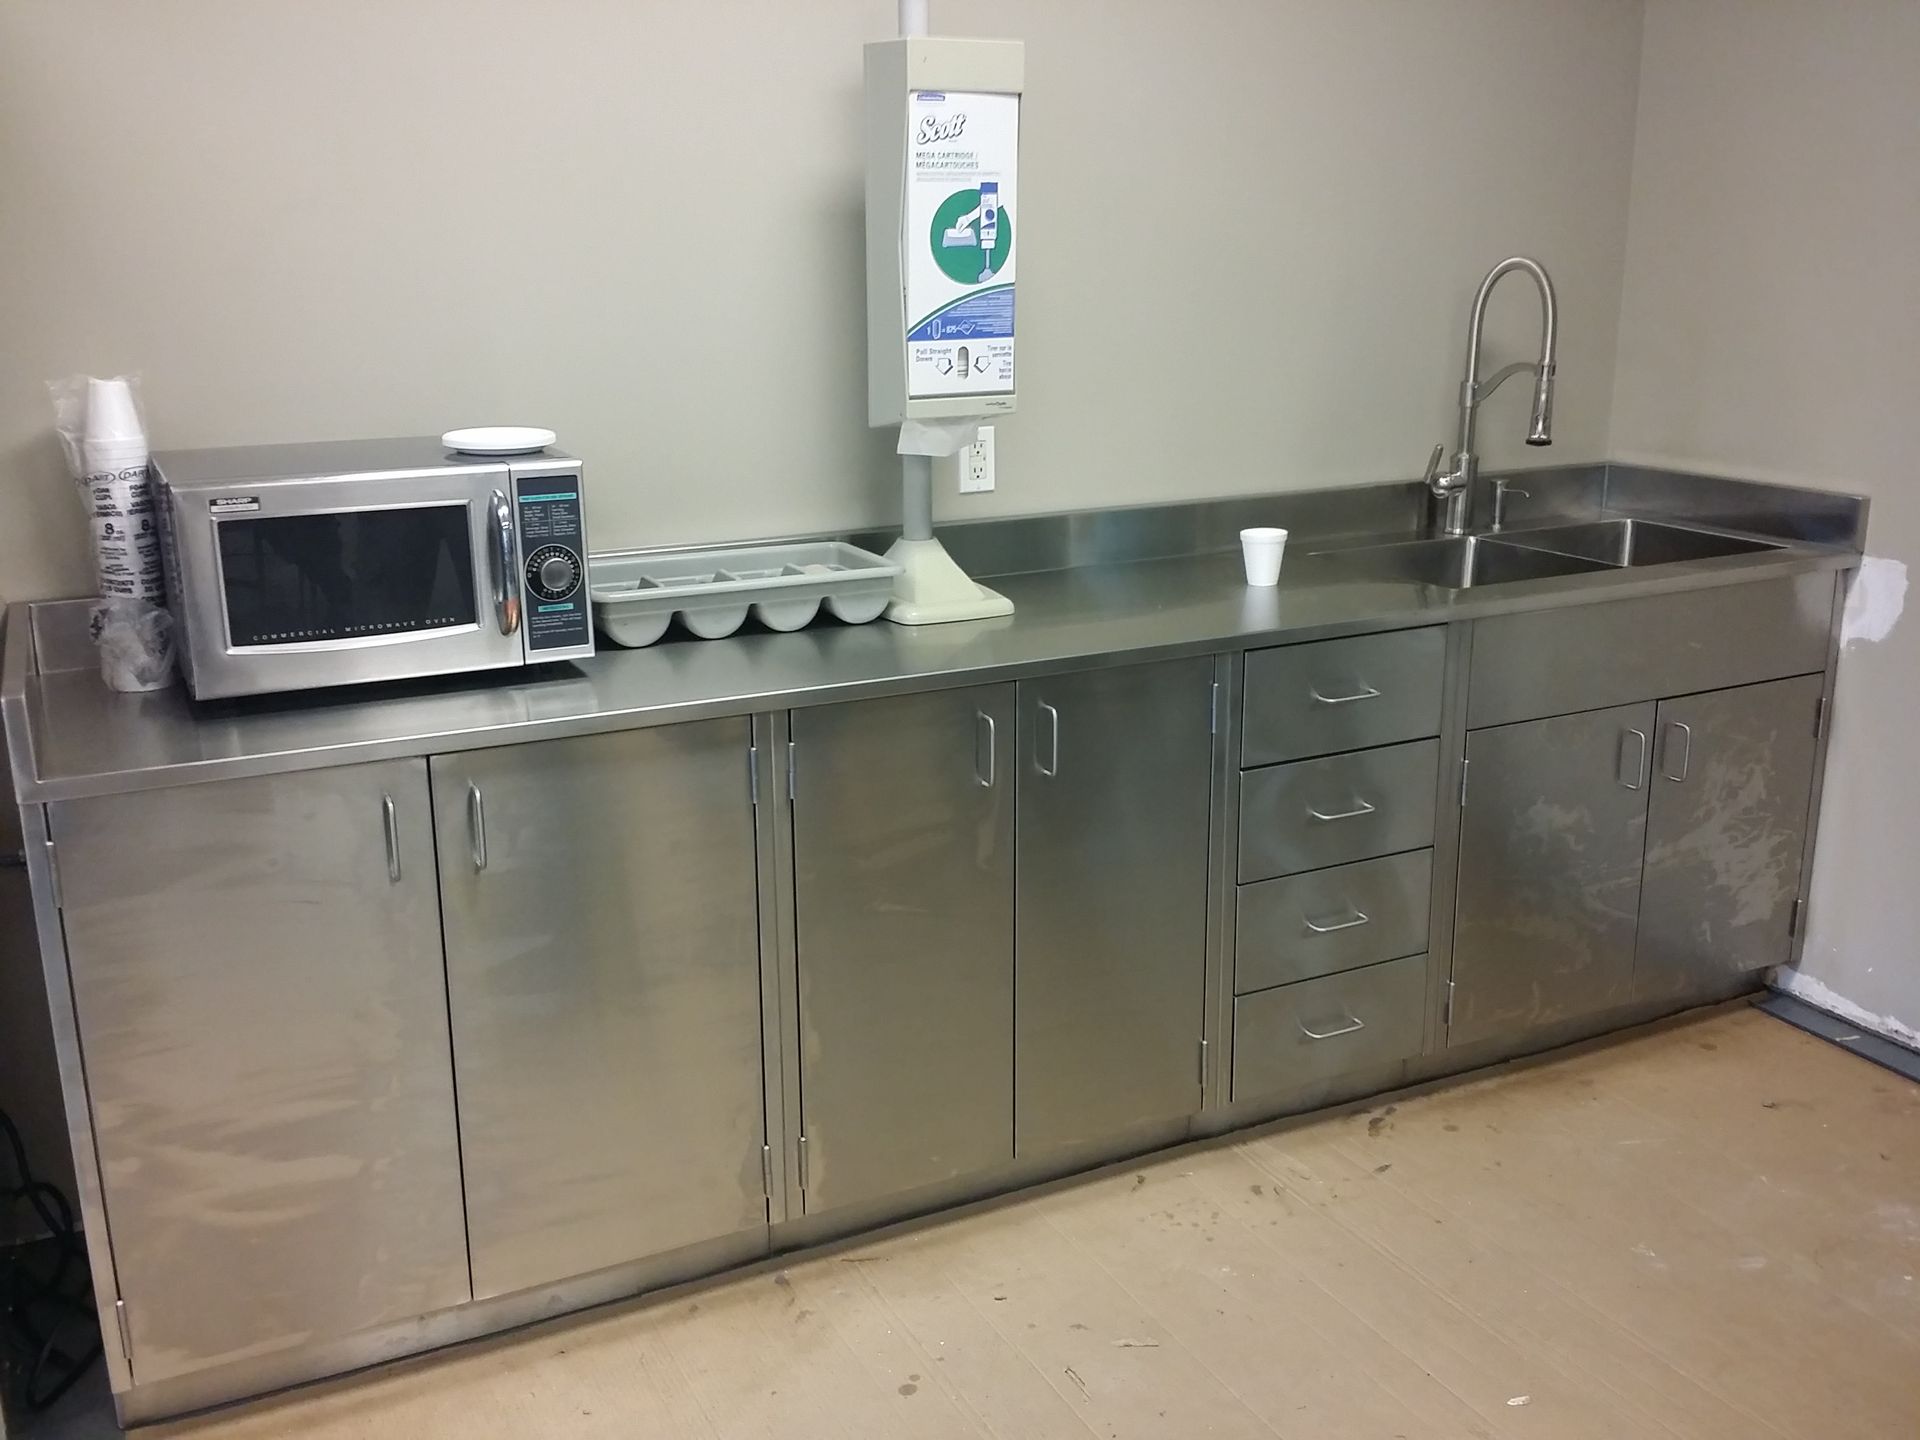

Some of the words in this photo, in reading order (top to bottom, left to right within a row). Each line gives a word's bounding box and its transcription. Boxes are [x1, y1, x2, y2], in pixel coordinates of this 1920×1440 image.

[916, 113, 967, 145] Scott
[937, 152, 974, 160] CARTRIDGE
[916, 161, 979, 170] MEGACARTOUCHES
[215, 497, 252, 505] SHARP
[104, 522, 115, 535] 8
[141, 519, 150, 531] 8
[252, 628, 336, 641] COMMERCIAL
[344, 619, 416, 632] MICROWAVE
[425, 616, 456, 625] OVEN
